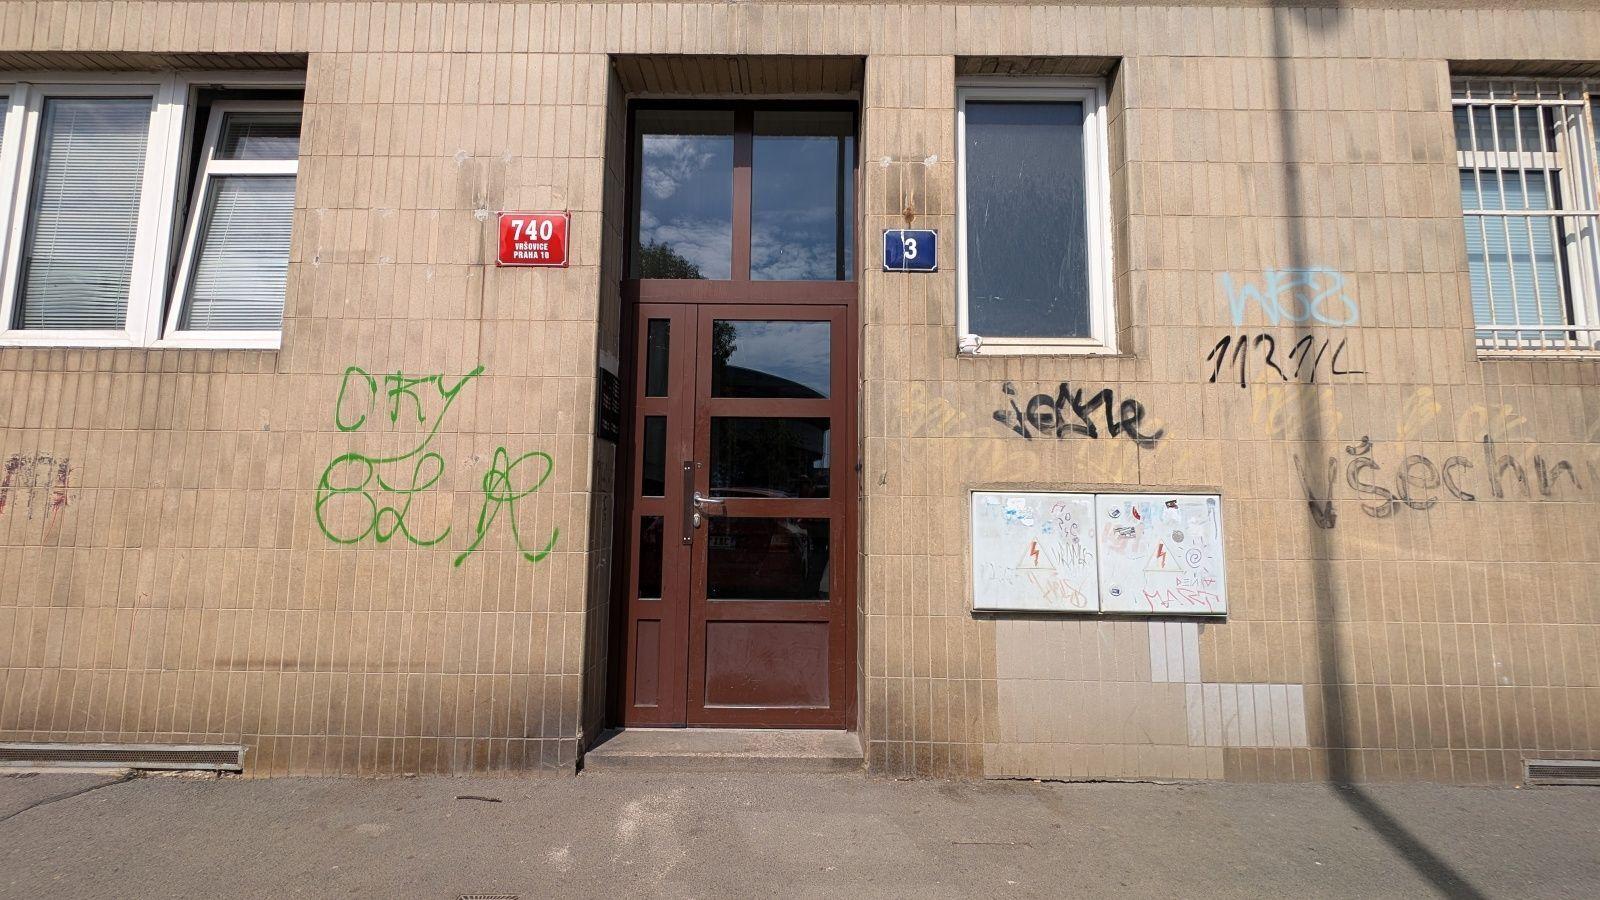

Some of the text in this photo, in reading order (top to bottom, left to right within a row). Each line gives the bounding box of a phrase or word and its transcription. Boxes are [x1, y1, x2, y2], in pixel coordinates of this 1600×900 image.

[511, 219, 553, 241] 740
[513, 251, 550, 259] PRAHA 10
[514, 241, 549, 251] VRŠOVICE
[904, 237, 917, 260] 3
[1292, 434, 1600, 530] Všechn
